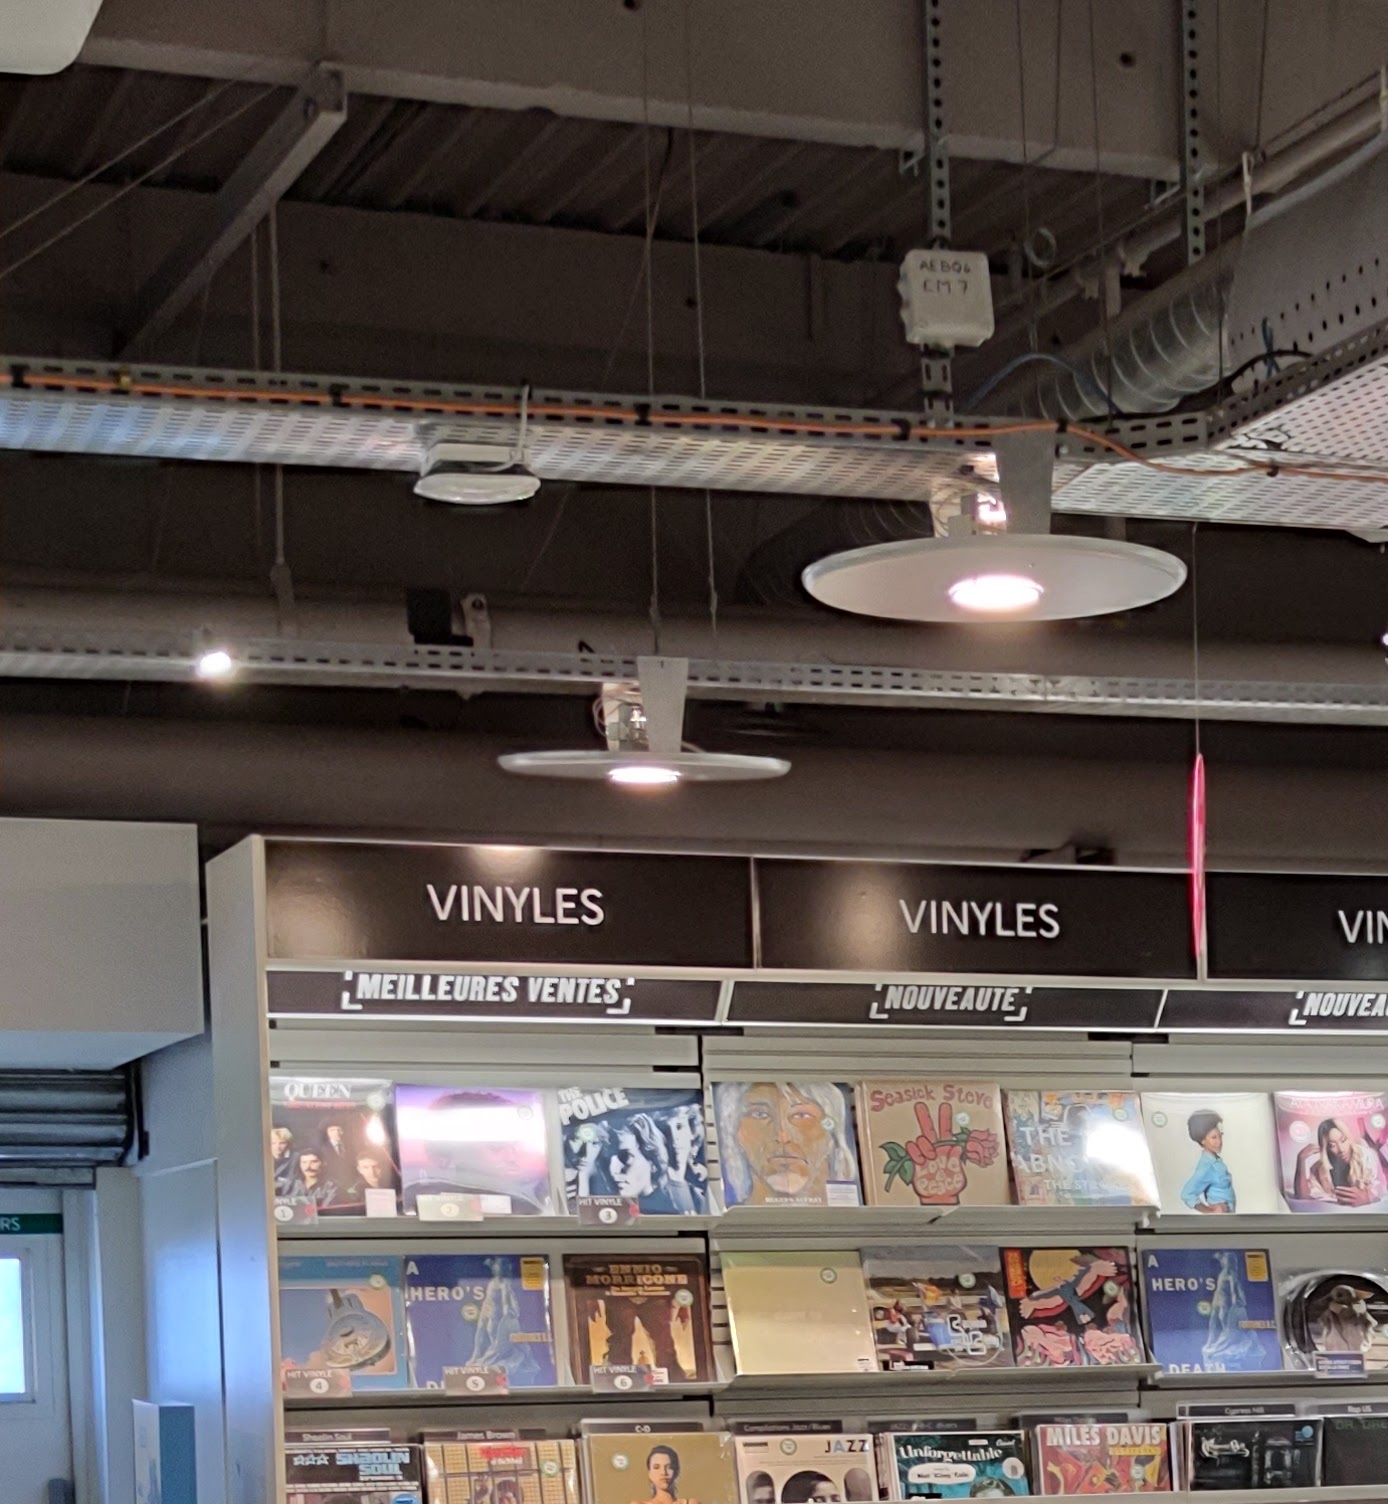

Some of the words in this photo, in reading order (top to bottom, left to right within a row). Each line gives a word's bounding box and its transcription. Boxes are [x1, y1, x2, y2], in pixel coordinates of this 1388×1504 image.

[426, 883, 605, 927] VINYLES
[898, 898, 1061, 940] VINYLES
[356, 973, 518, 1003] MEILLEURES
[527, 978, 622, 1006] VENTES
[284, 1082, 353, 1099] QUEEN
[870, 1084, 937, 1112] Seasick
[943, 1083, 994, 1110] Steve
[560, 1088, 630, 1125] POLICE
[1020, 1126, 1071, 1147] THE
[918, 1174, 965, 1196] Peace
[406, 1260, 419, 1275] A
[609, 1263, 662, 1275] ENNIO
[1148, 1255, 1159, 1268] A
[586, 1274, 688, 1286] MORRICONE
[1151, 1276, 1217, 1293] HERO'S
[410, 1285, 485, 1303] HERO'S
[1168, 1362, 1227, 1374] DEATH
[457, 1431, 484, 1440] James
[485, 1430, 516, 1440] Brown
[1046, 1425, 1101, 1447] MILES
[1106, 1425, 1162, 1447] DAVIS
[824, 1438, 869, 1454] JAZZ
[899, 1444, 1003, 1463] Unforgettable
[358, 1464, 403, 1476] SOUL
